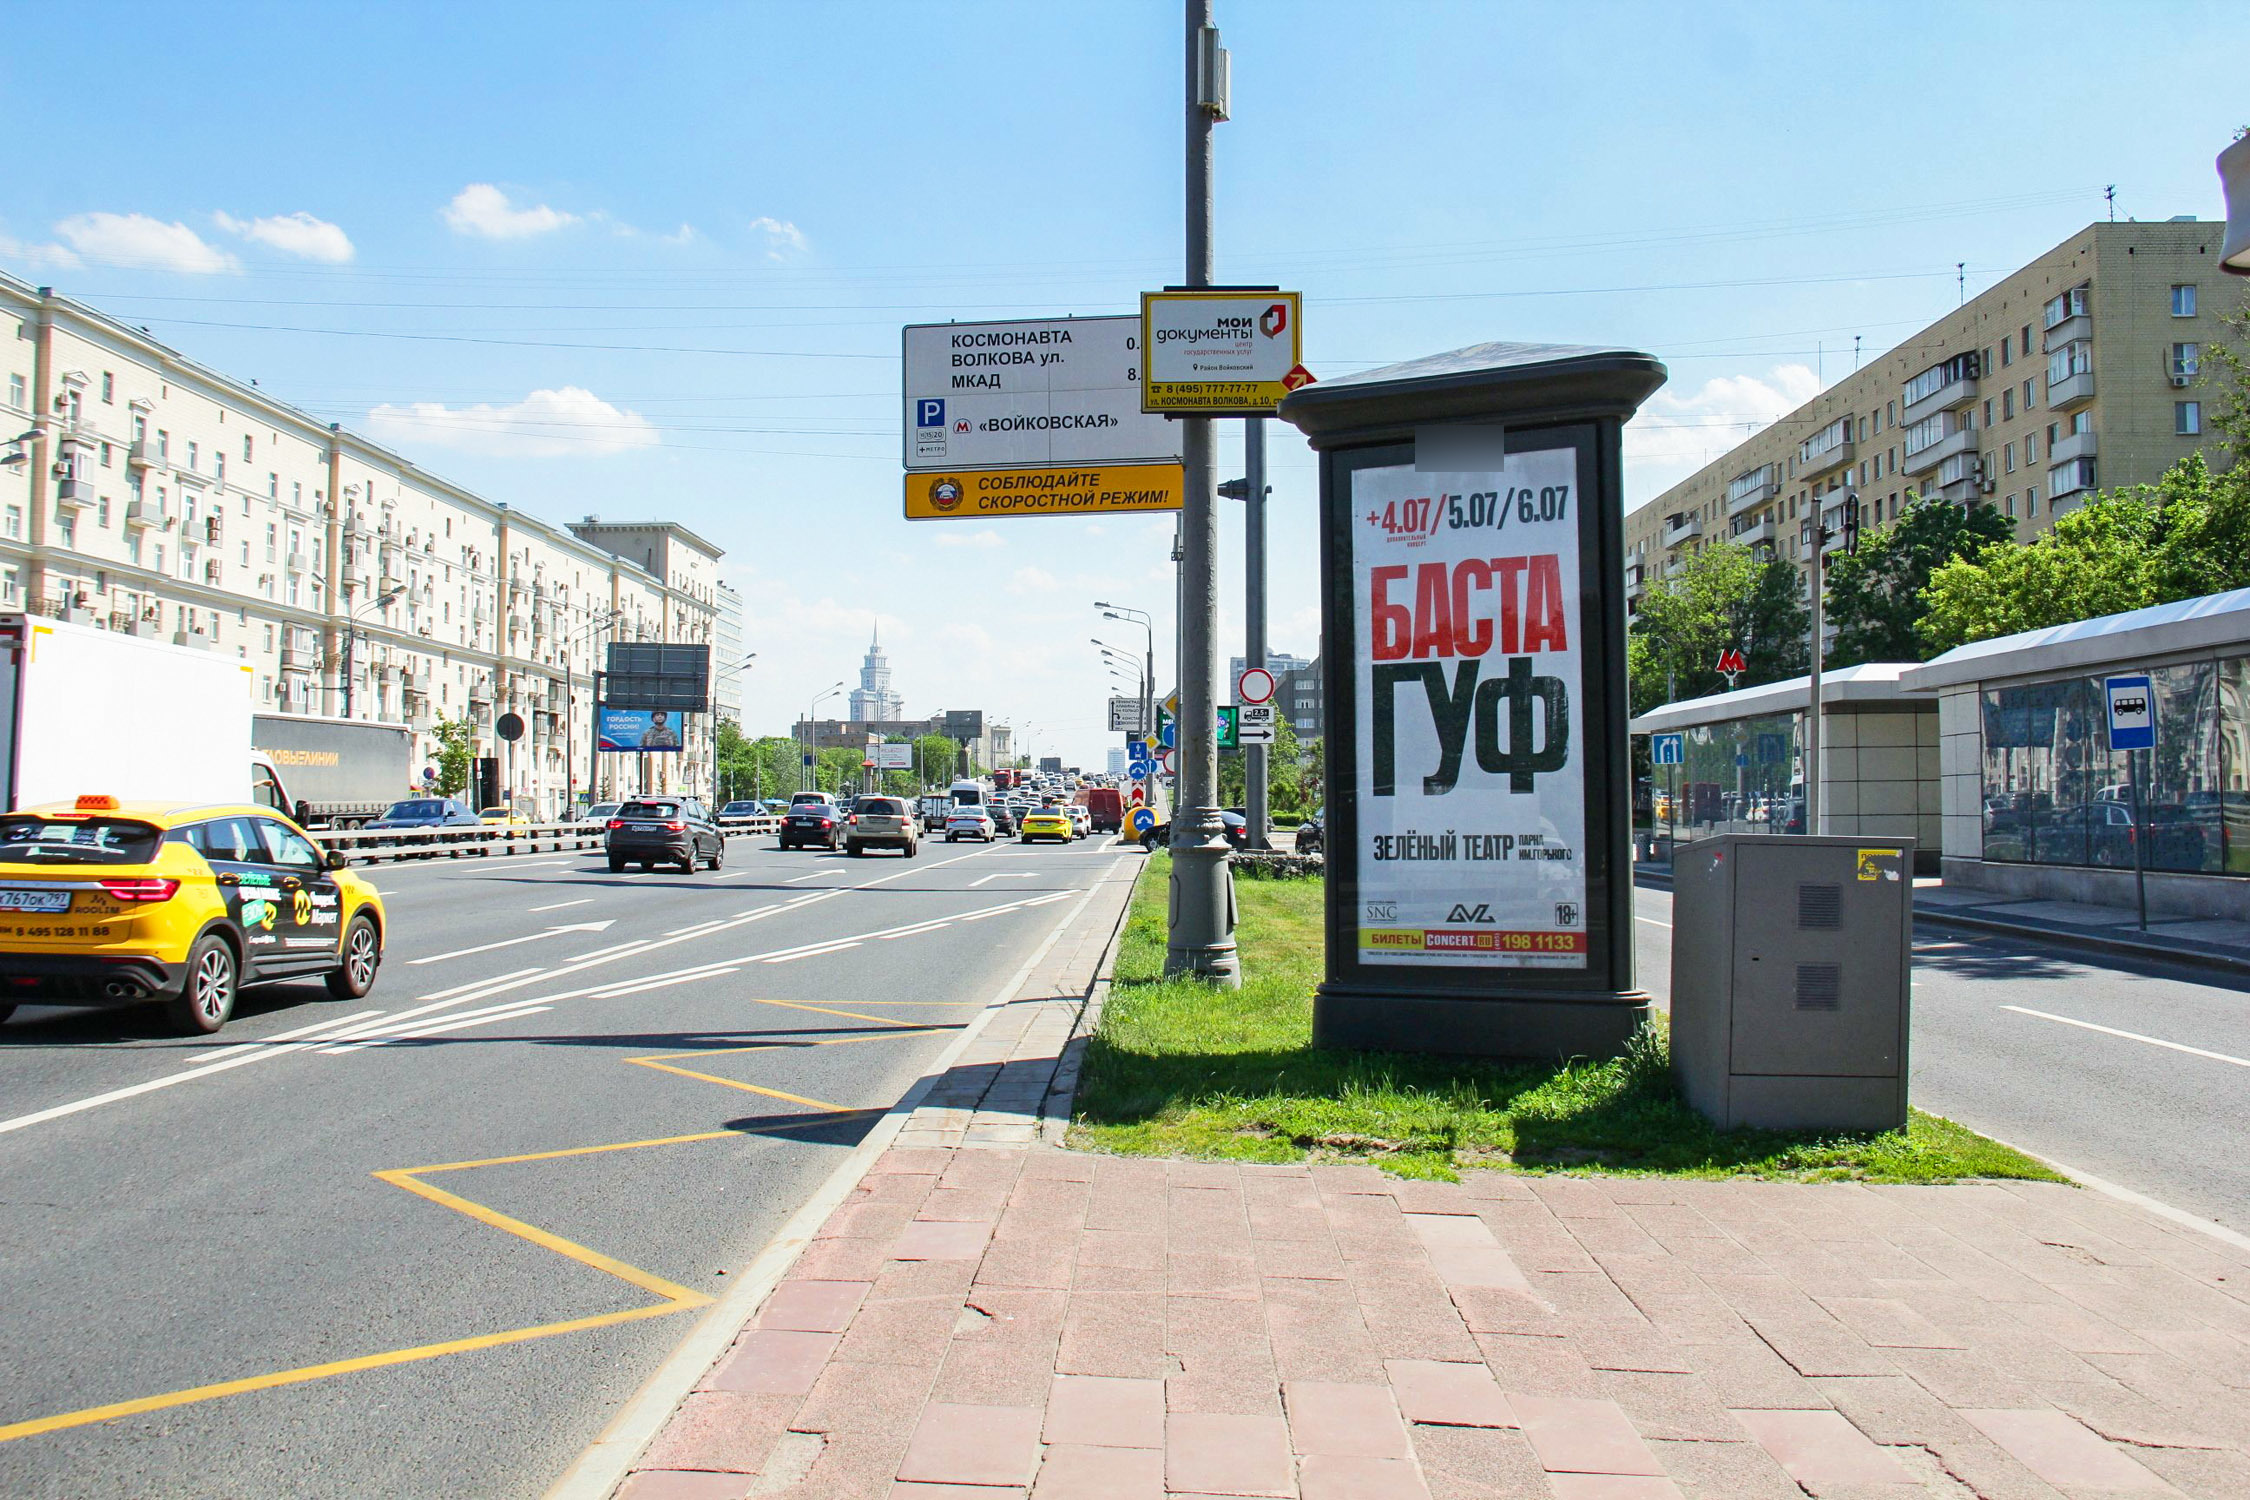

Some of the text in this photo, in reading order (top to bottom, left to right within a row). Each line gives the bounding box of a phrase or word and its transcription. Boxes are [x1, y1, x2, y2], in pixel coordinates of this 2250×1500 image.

[1217, 317, 1253, 328] мои
[951, 329, 1072, 349] КОСМОНАВТА
[1126, 337, 1140, 350] 0.
[1156, 329, 1253, 344] документы
[951, 351, 1065, 369] ВОЛКОВА ул.
[951, 373, 1001, 391] МКАД
[1127, 368, 1141, 381] 8.
[1166, 384, 1258, 394] 8 (495) 777-77-77
[1161, 396, 1212, 406] КОСМОНАВТА
[1213, 397, 1251, 406] ВОЛКОВА,
[1252, 398, 1259, 406] д.
[1259, 396, 1272, 406] 10,
[924, 402, 940, 425] P
[979, 414, 1119, 433] «ВОЙКОВСКАЯ»
[978, 472, 1101, 491] СОБЛЮДАЙТЕ
[978, 489, 1169, 510] СКОРОСТНОЙ РЕЖИМ!
[1371, 553, 1568, 661] БАСТА
[1372, 656, 1570, 797] ГУФ
[1373, 829, 1514, 861] ЗЕЛЁНЫЙ ТЕАТР
[1366, 905, 1398, 919] SNC
[1556, 904, 1577, 926] 18+
[16, 927, 24, 936] 8
[27, 927, 51, 936] 495
[54, 927, 75, 936] 128
[79, 927, 89, 936] 11
[1371, 933, 1422, 945] БИЛЕТЫ
[1502, 934, 1575, 951] 198 1133
